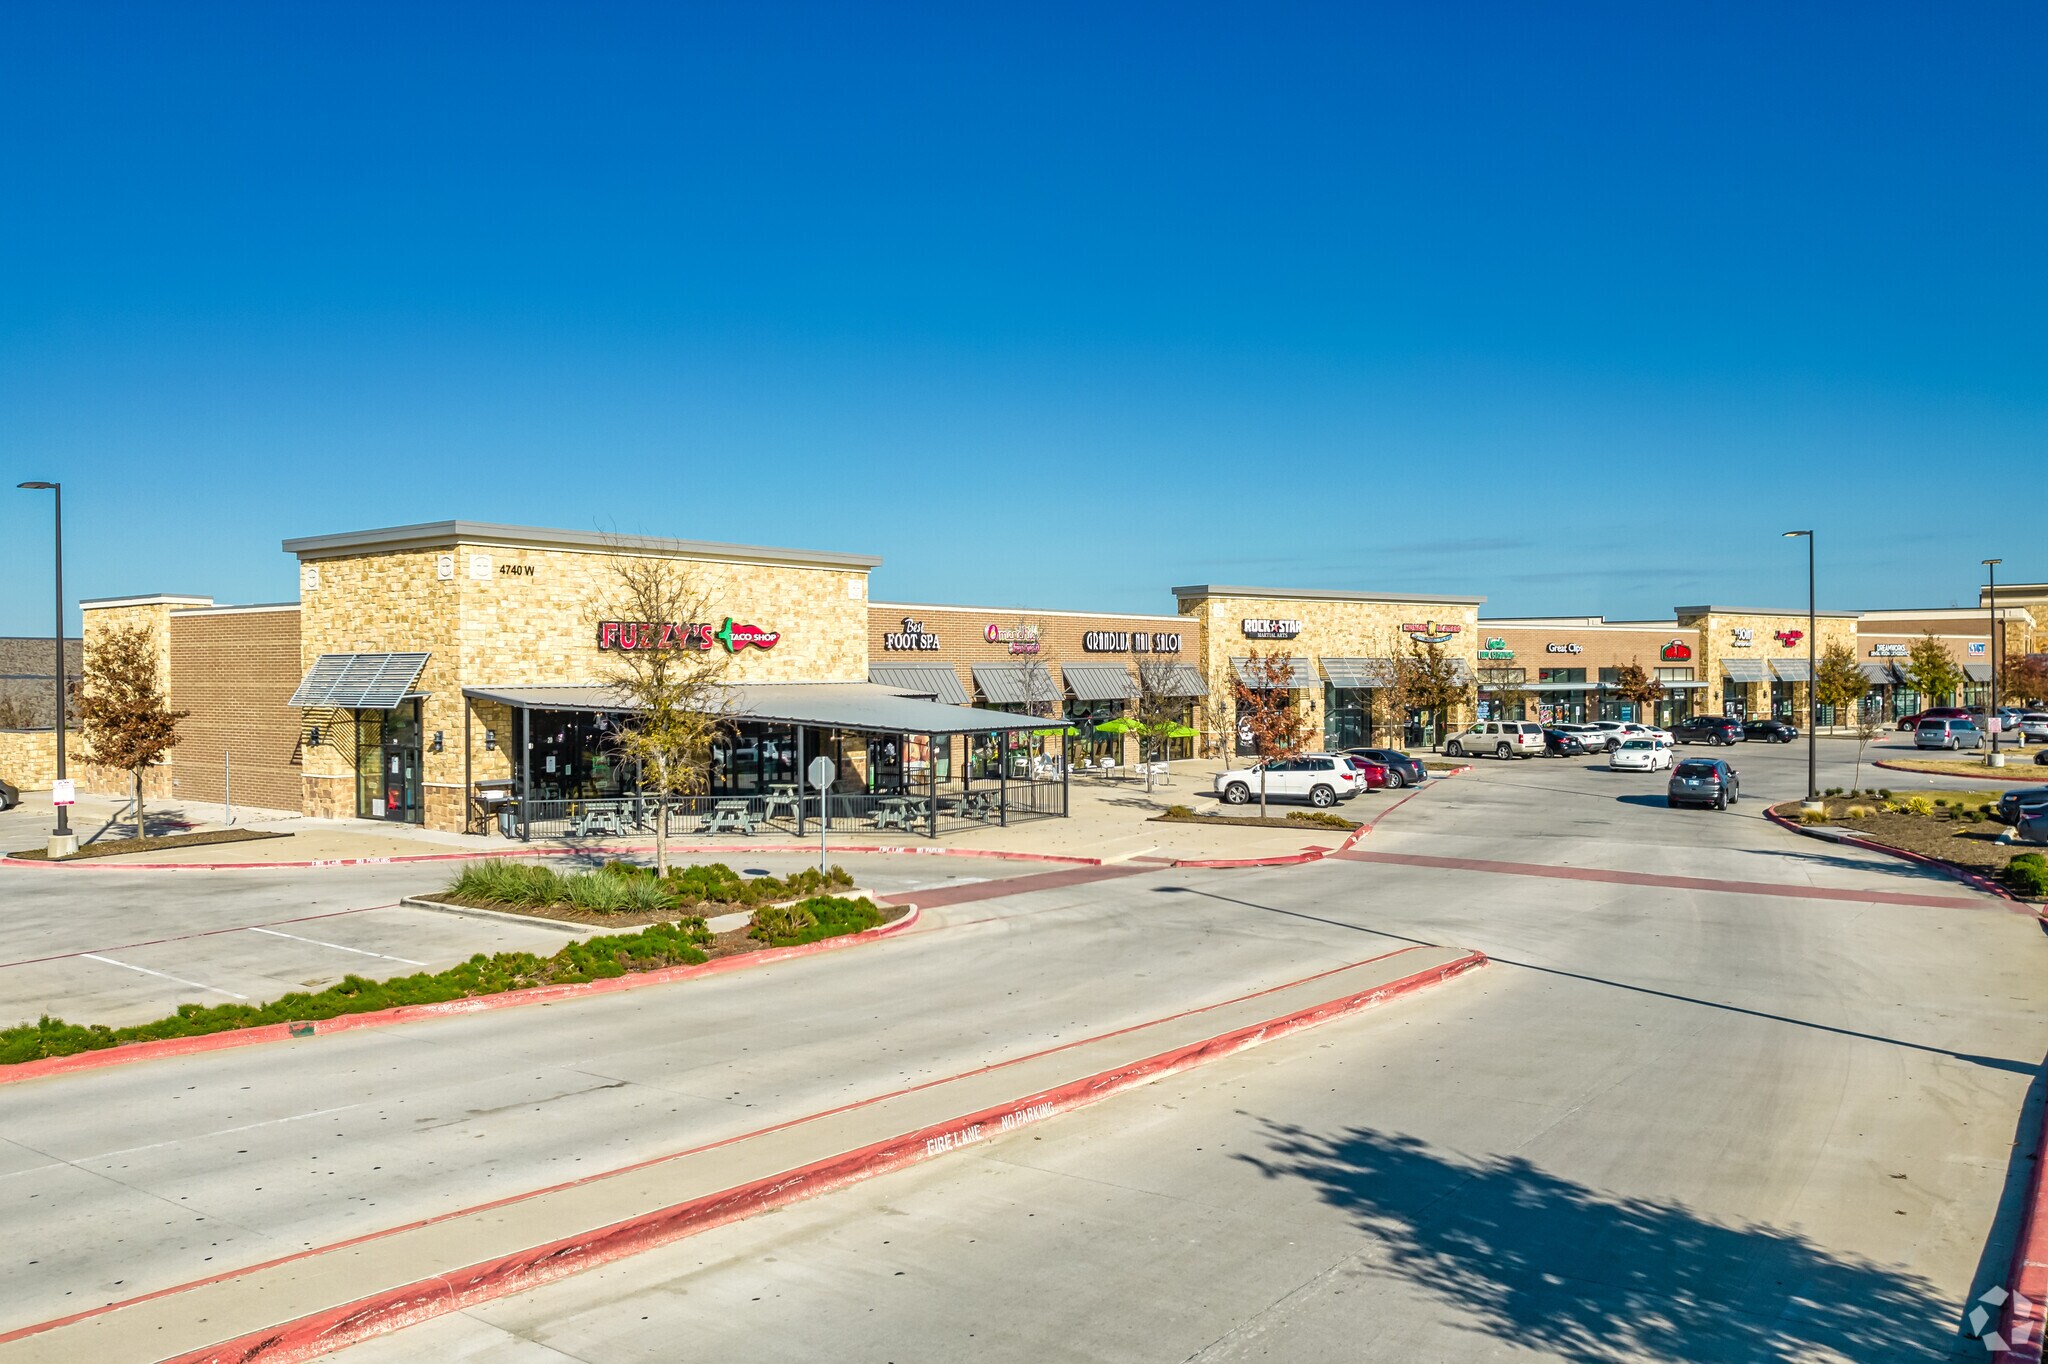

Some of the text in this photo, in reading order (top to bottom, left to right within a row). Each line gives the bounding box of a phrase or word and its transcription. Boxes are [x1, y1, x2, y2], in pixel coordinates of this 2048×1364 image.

[499, 564, 535, 576] 4740 W
[905, 618, 925, 633] Best
[1244, 619, 1302, 633] ROCK STAR
[601, 622, 713, 650] FUZZY'S
[730, 633, 777, 642] TACO SHOP
[887, 633, 941, 650] FOOT SPA
[1086, 631, 1182, 651] GRANDLUX NAIL SALON
[1548, 643, 1568, 653] Great
[926, 1101, 1055, 1156] FIRE LANE NO PARKING
